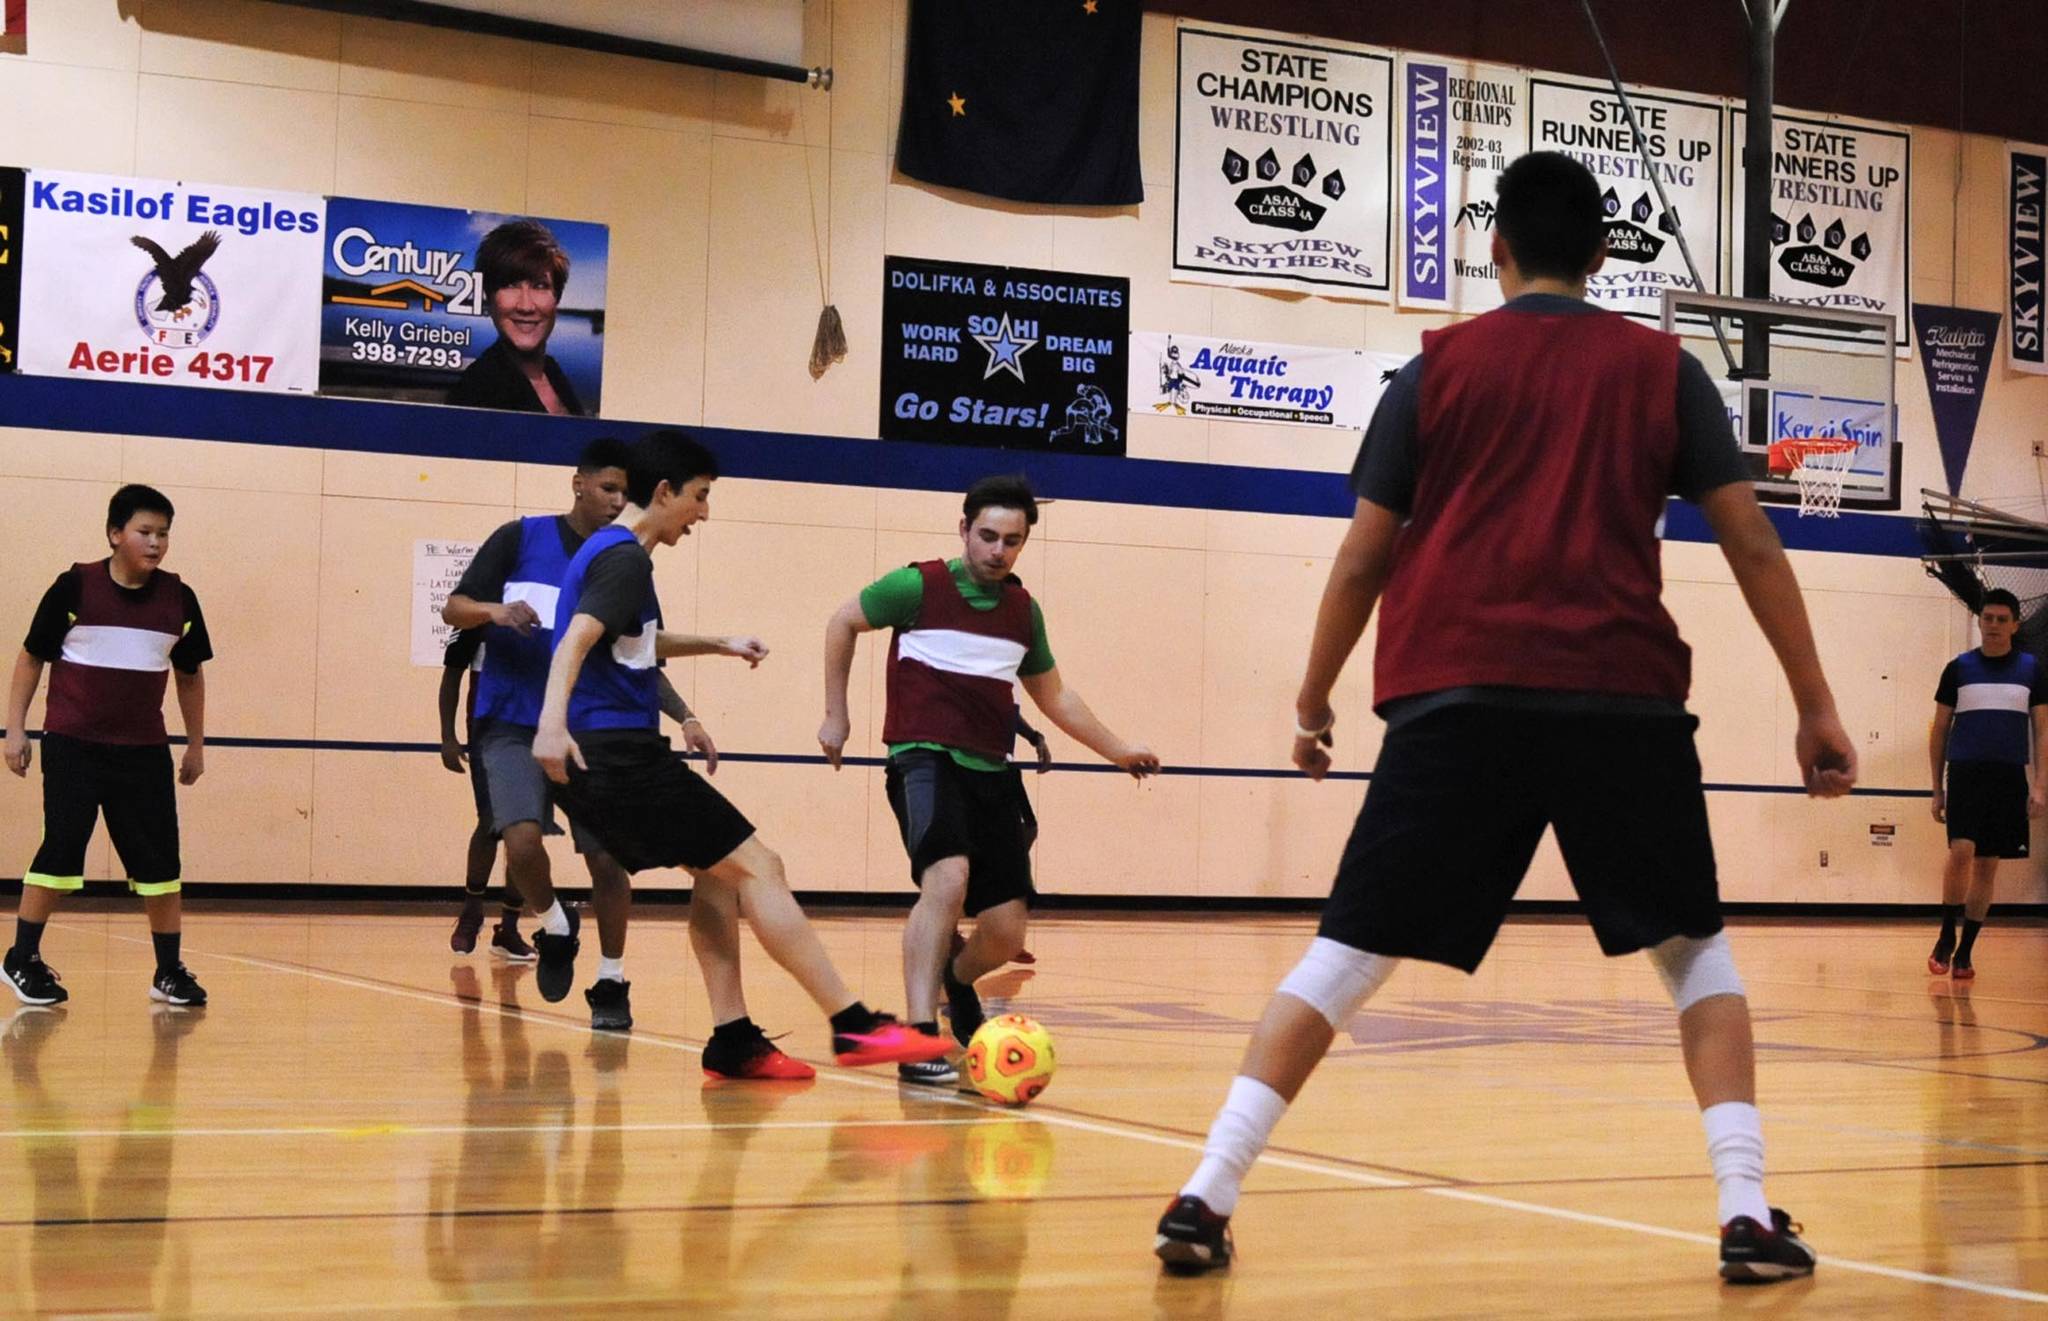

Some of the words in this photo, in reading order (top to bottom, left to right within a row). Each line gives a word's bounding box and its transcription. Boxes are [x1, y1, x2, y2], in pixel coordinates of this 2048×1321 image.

[1241, 49, 1328, 82] STATE
[1197, 72, 1373, 118] CHAMPIONS
[1449, 77, 1516, 106] REGIONAL
[1452, 102, 1512, 127] CHAMPS
[1210, 105, 1360, 146] WRESTLING
[1456, 136, 1502, 153] 2002-03
[1678, 139, 1711, 162] UP
[1785, 128, 1856, 158] STATE
[1452, 154, 1487, 171] Region
[1774, 152, 1856, 184] NNERS
[1868, 165, 1899, 188] UP
[1414, 72, 1440, 284] SKYVIEW
[1262, 194, 1300, 207] ASAA
[1774, 178, 1883, 212] RESTLING
[32, 180, 174, 220] Kasilof
[187, 195, 320, 235] Eagles
[1249, 204, 1296, 217] CLASS
[1607, 228, 1642, 240] ASAA
[1213, 236, 1362, 258] SKYVIEW
[1195, 246, 1373, 278] PANTHERS
[1802, 252, 1832, 265] ASAA
[2014, 165, 2040, 351] SKYVIEW
[332, 227, 462, 284] Century
[447, 270, 484, 315] 21
[1454, 259, 1499, 280] Wrestli
[1586, 271, 1695, 288] KYVIEW
[1790, 262, 1827, 275] CLASS
[1830, 266, 1845, 277] 4A
[892, 271, 976, 295] DOLIFKA
[984, 280, 996, 296] &
[1003, 281, 1122, 308] ASSOCIATES
[1586, 286, 1661, 299] NTHE
[345, 317, 393, 343] Kelly
[400, 322, 470, 346] Griebel
[902, 323, 961, 343] WORK
[352, 341, 462, 368] 398-7293
[904, 344, 958, 363] HARD
[1046, 335, 1113, 355] DREAM
[1219, 342, 1254, 356] Alaska
[1936, 348, 1976, 360] Mechanical
[68, 342, 174, 376] Aerie
[188, 352, 274, 383] 4317
[1062, 356, 1096, 373] BIG
[1190, 348, 1287, 377] Aquatic
[1932, 359, 1979, 372] Refrigeration
[1937, 371, 1965, 382] Service
[1230, 376, 1333, 410] Therapy
[894, 392, 939, 420] Go
[949, 396, 1049, 428] Stars!
[1195, 403, 1231, 416] Physical
[1237, 407, 1293, 420] Occupational
[1299, 412, 1330, 423] Speech
[446, 544, 474, 555] Warm
[445, 569, 464, 577] LUN
[430, 594, 446, 602] SID
